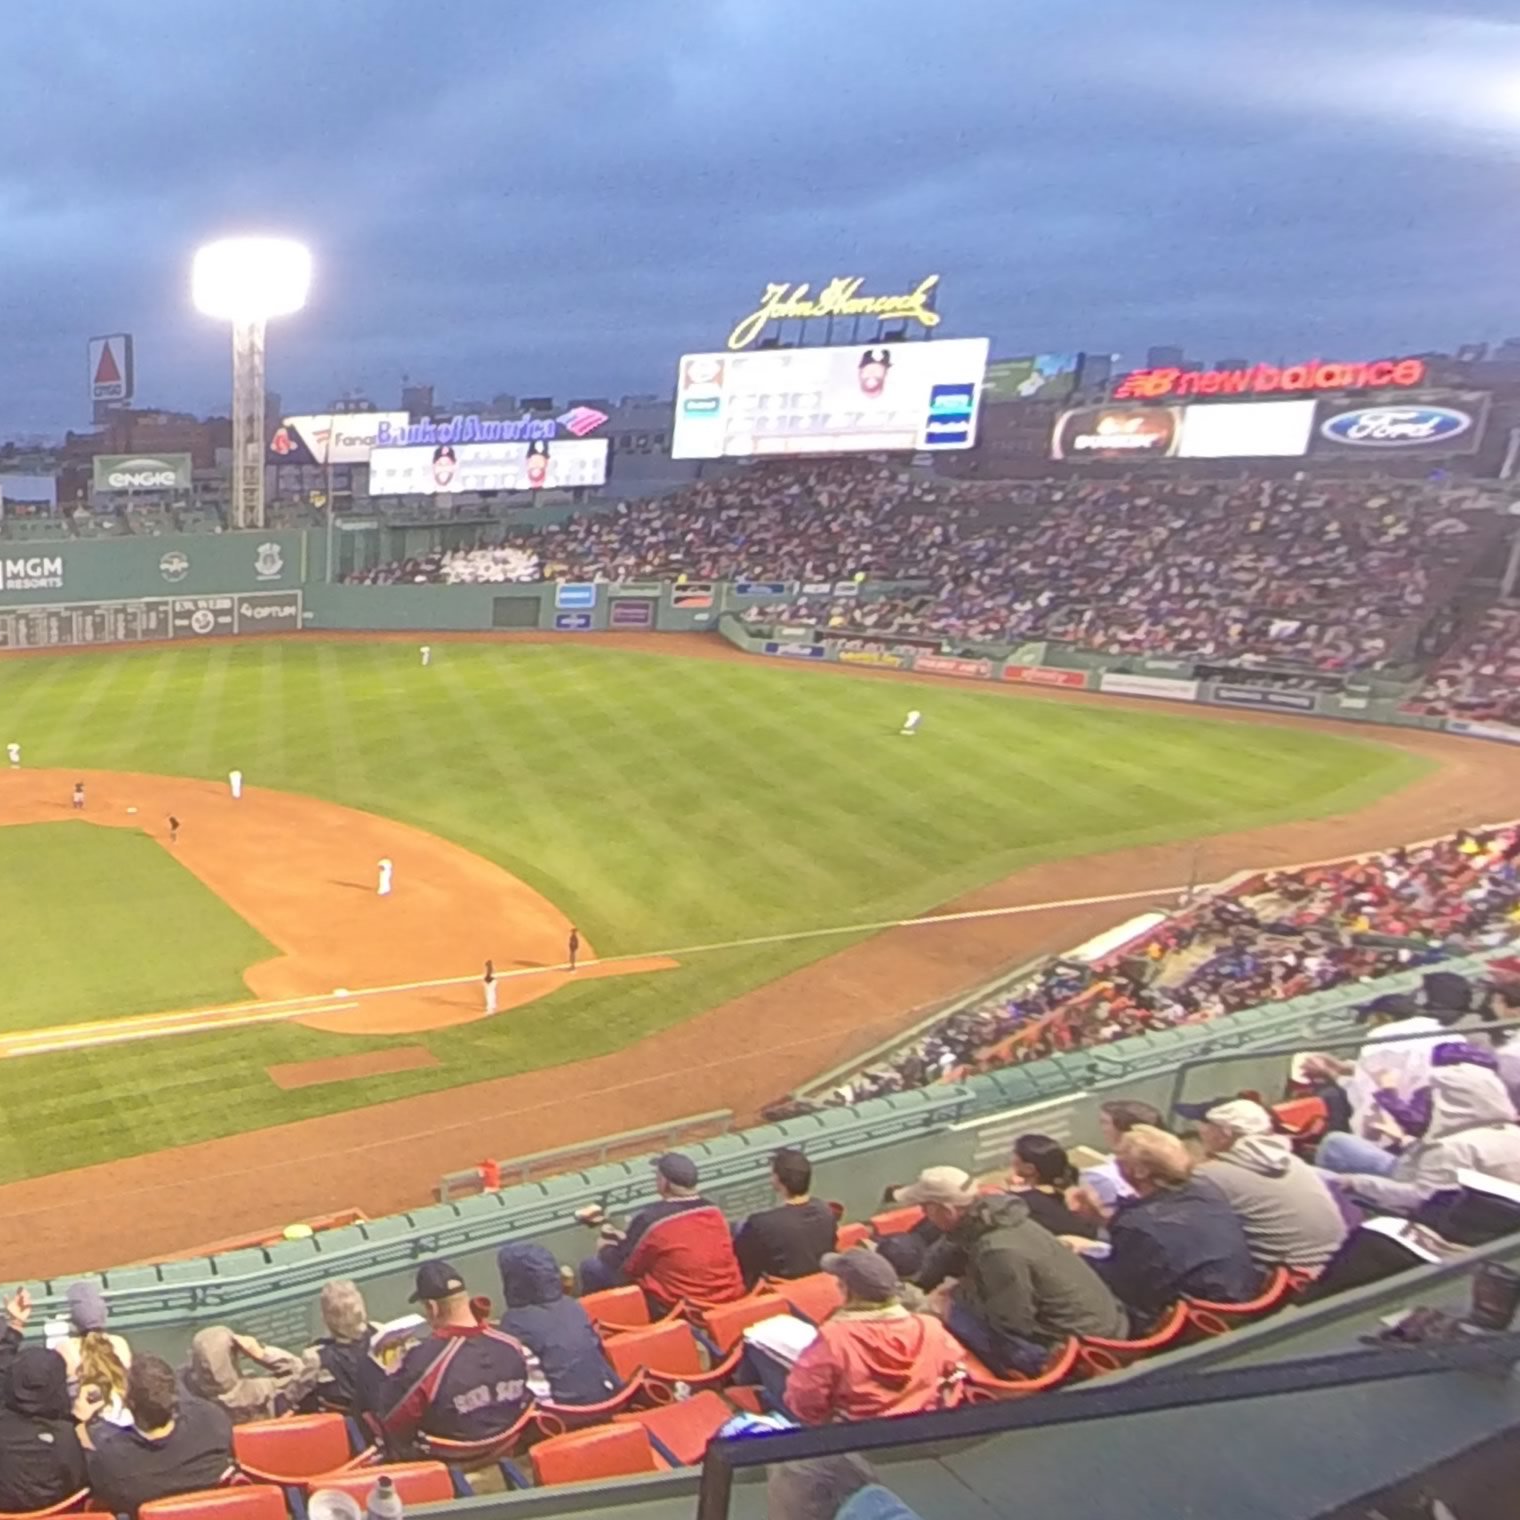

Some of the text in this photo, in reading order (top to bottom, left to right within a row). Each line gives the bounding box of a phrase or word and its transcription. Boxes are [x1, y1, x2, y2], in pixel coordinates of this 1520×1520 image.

[1252, 359, 1424, 392] balance
[1347, 411, 1443, 439] Ford
[5, 556, 63, 578] MGM
